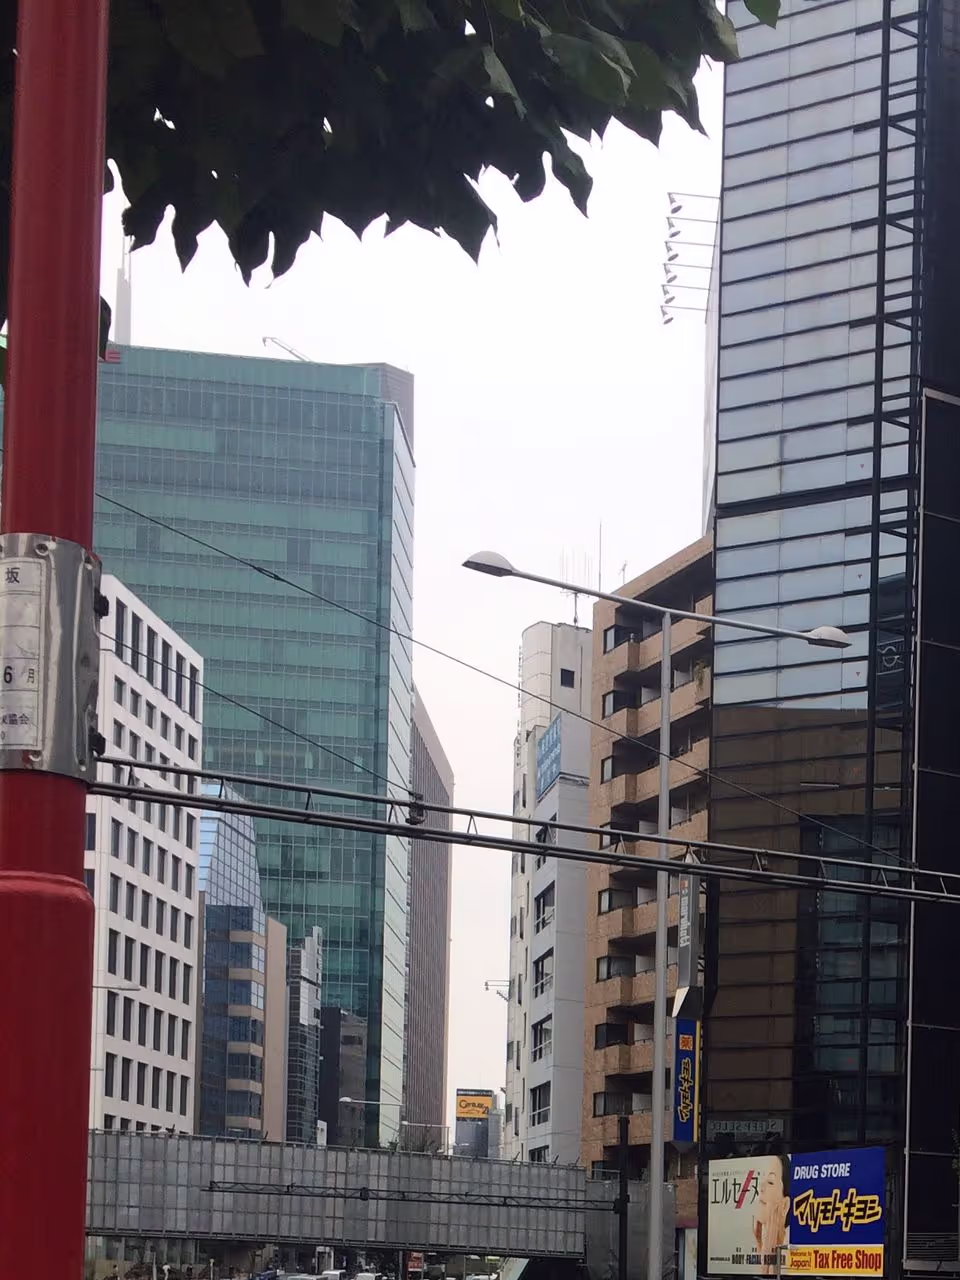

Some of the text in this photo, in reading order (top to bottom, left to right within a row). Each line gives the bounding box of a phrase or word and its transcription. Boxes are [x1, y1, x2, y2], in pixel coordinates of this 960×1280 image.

[3, 665, 13, 684] 6
[793, 1162, 851, 1180] DRUG STORE
[793, 1188, 883, 1233] マツモトキヨシ
[813, 1249, 881, 1271] Tax Free Shop
